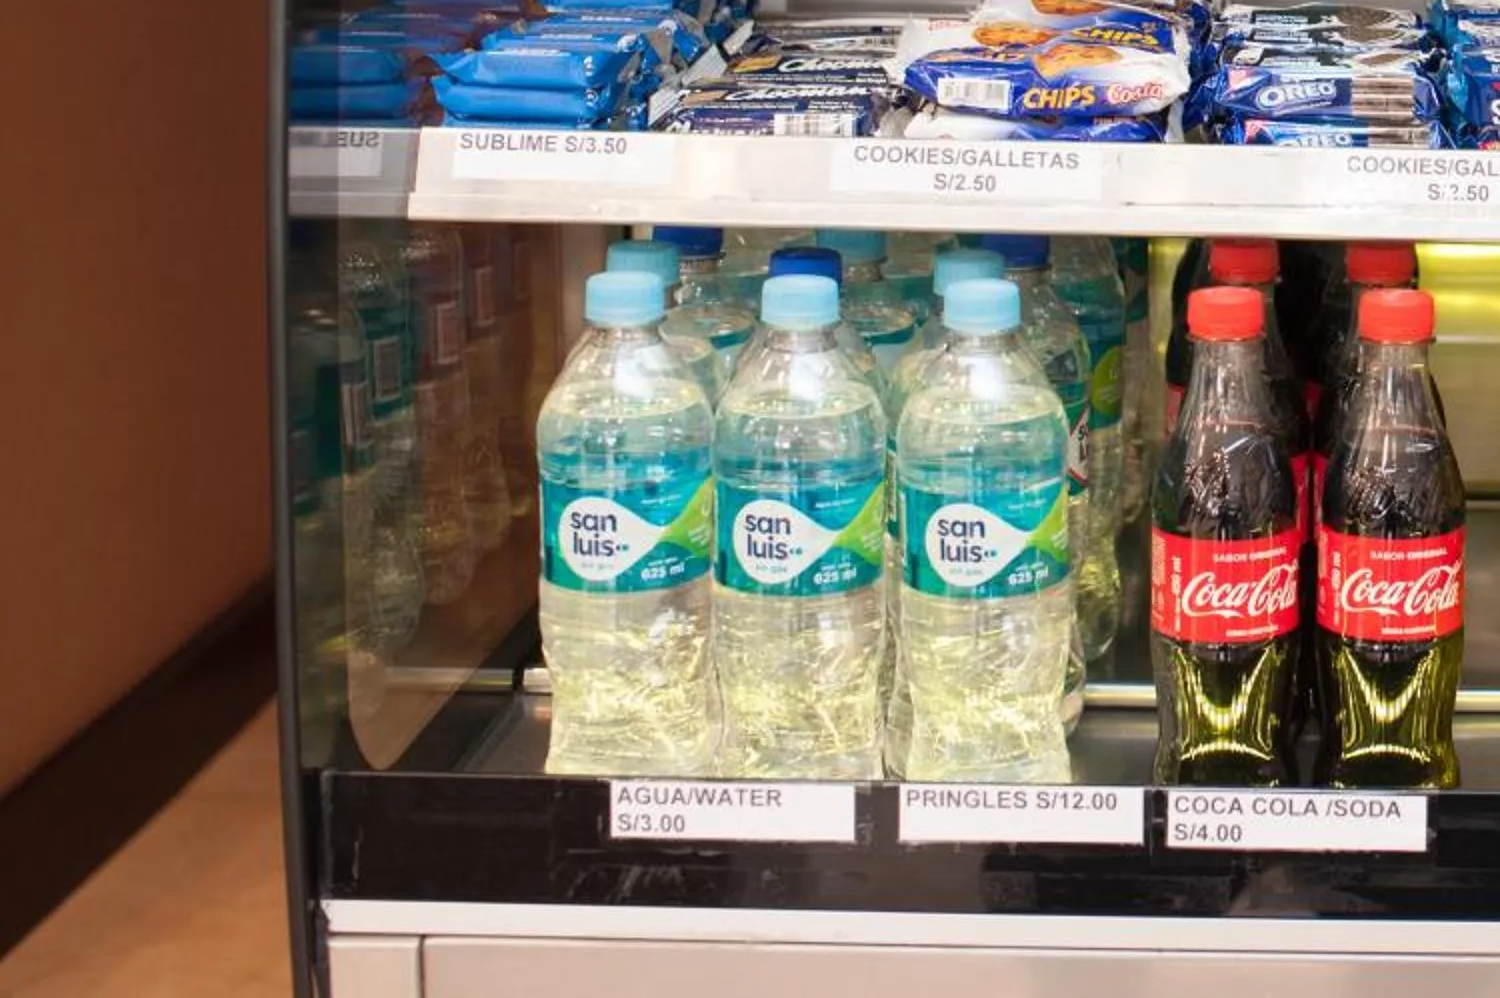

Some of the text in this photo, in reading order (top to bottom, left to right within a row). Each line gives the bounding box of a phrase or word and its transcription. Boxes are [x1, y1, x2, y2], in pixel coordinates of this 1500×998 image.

[1023, 86, 1096, 110] CHIPS
[1260, 81, 1336, 108] OREO
[460, 132, 627, 155] SUBLIME S/3.50
[853, 143, 1080, 170] COOKIES/GALLETAS
[933, 172, 997, 193] S/2.50
[570, 511, 617, 533] san
[744, 513, 791, 535] san
[937, 519, 986, 539] san
[573, 531, 615, 557] luis
[747, 533, 788, 560] luis
[940, 538, 983, 563] luis
[617, 786, 782, 807] AGUA/WATER
[906, 789, 1118, 811] PRINGLES S/12.00
[1174, 795, 1401, 818] COCA COLA /SODA
[617, 813, 686, 833] S/3.00
[1174, 823, 1243, 843] S/4.00
